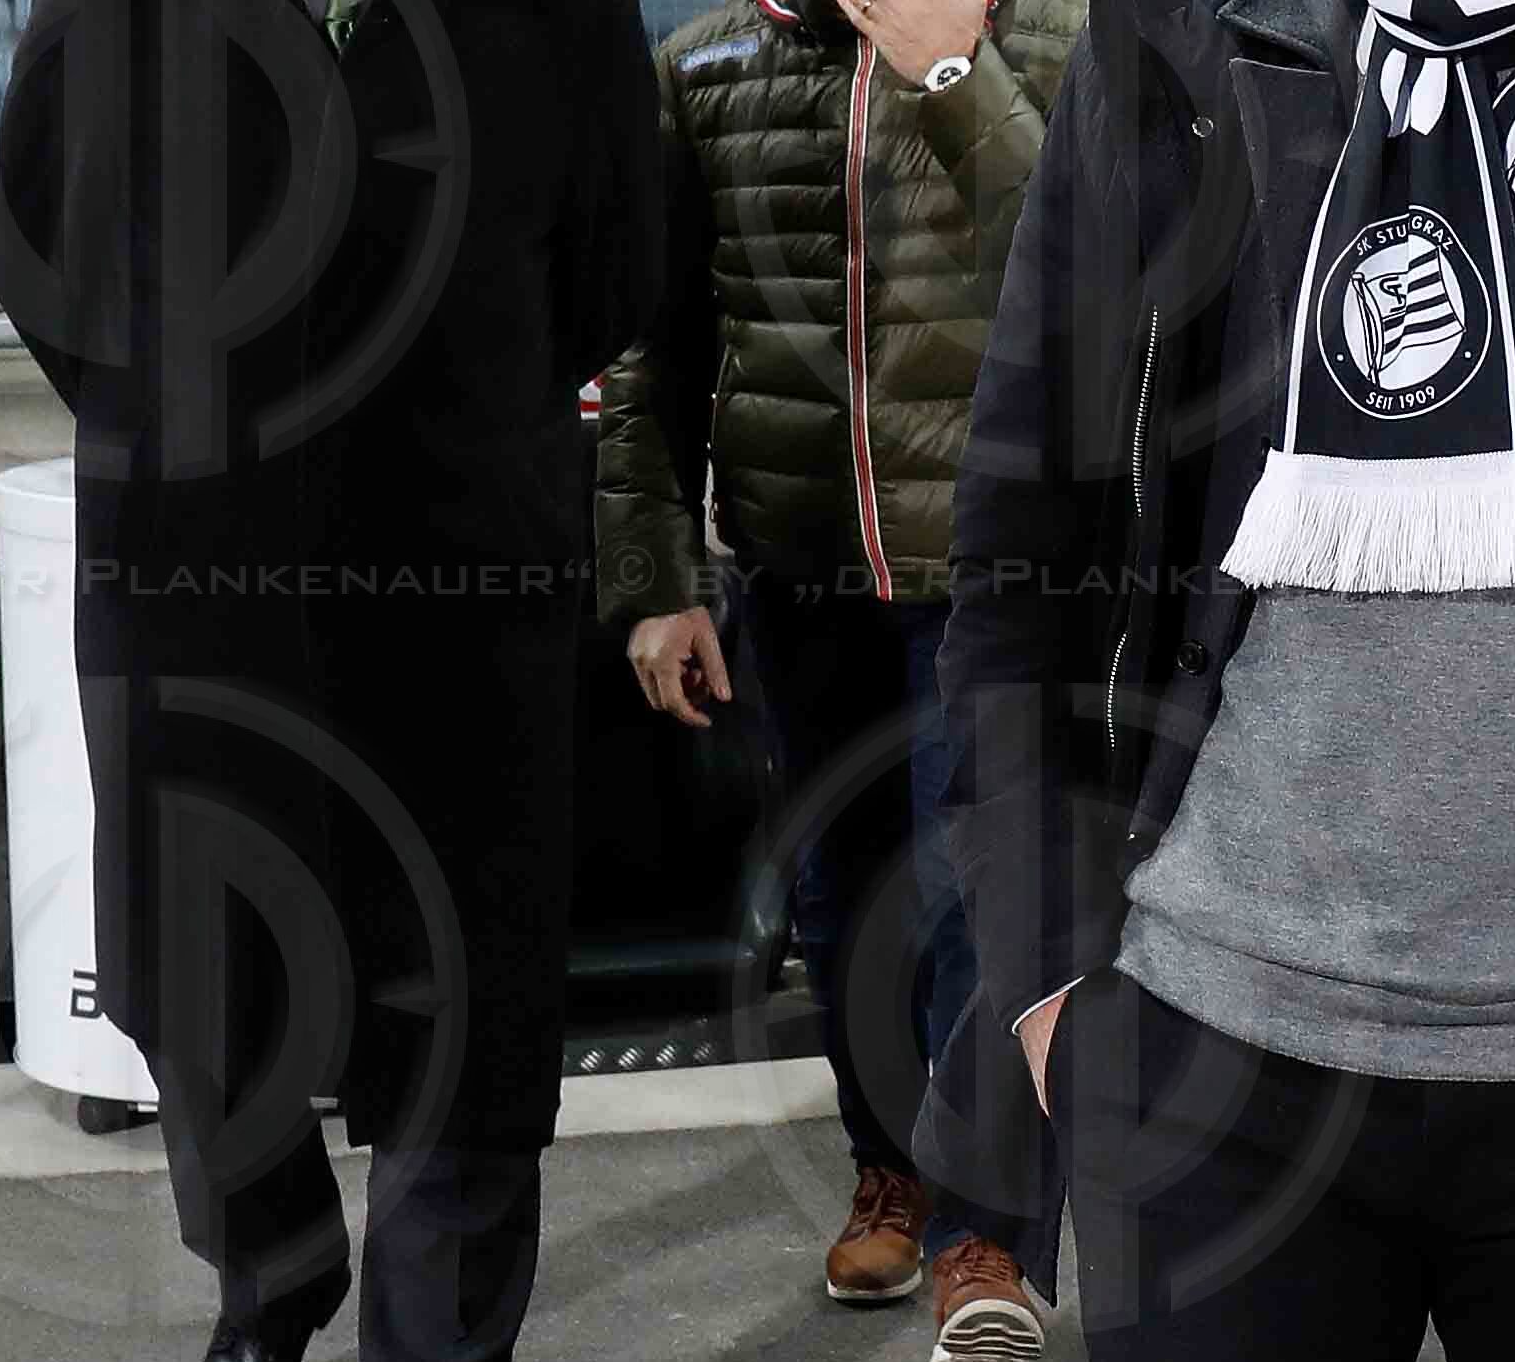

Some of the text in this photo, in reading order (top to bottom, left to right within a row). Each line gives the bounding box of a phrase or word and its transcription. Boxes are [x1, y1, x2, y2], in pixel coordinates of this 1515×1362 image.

[1356, 215, 1454, 257] SK STU GRAZ
[1365, 385, 1435, 411] SEIT 1909
